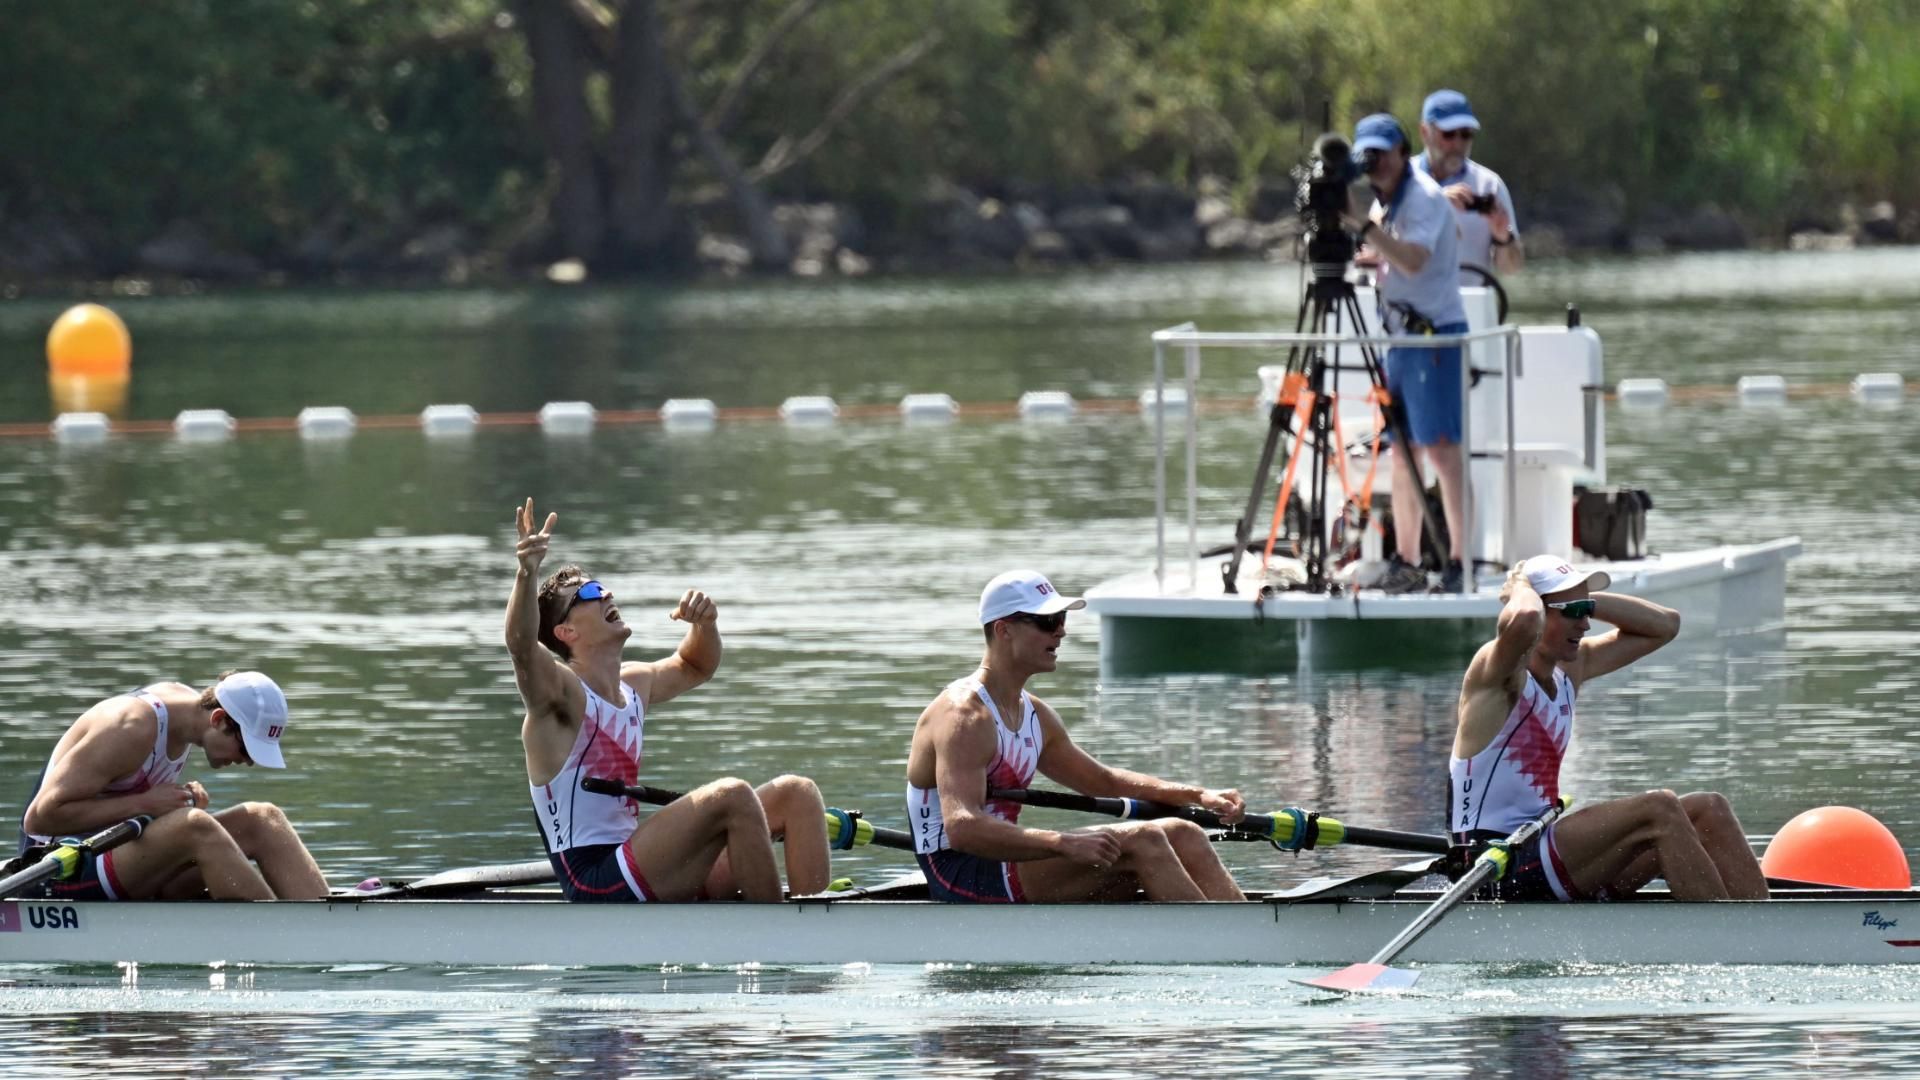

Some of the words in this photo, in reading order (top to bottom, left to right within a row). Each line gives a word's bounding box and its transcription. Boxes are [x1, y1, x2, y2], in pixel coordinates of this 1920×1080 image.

[1036, 583, 1054, 595] US
[268, 725, 283, 738] US
[1461, 780, 1473, 828] USA
[549, 802, 564, 848] USA
[921, 808, 931, 850] USA
[28, 906, 79, 929] USA
